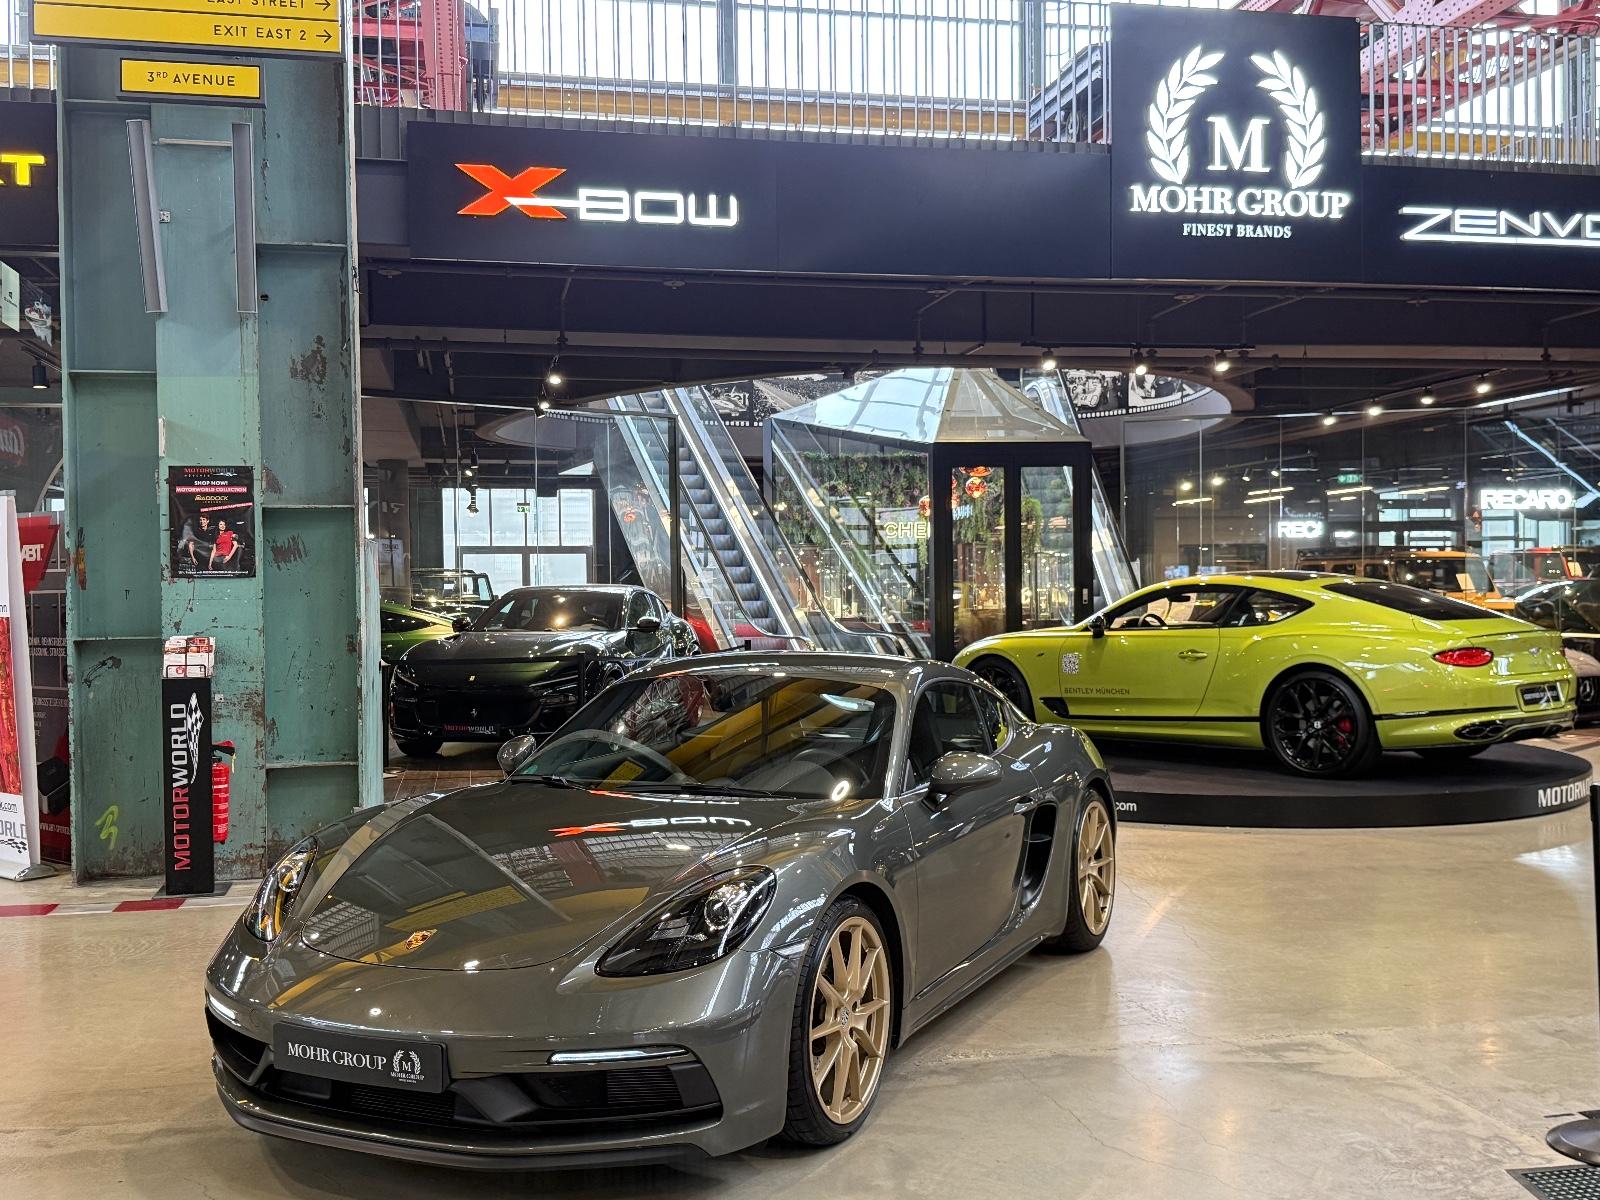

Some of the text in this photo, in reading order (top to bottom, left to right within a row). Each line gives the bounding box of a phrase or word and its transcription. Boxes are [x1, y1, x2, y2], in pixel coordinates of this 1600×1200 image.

[213, 25, 307, 41] EXIT EAST 2
[172, 73, 236, 87] AVENUE
[1206, 116, 1271, 173] M
[1130, 185, 1351, 219] MOHR GROUP
[1182, 223, 1292, 239] FINEST BRANDS
[1480, 488, 1573, 510] RECARO
[21, 544, 45, 562] ABT
[1064, 686, 1130, 695] BENTLEY MÜNCHEN
[170, 703, 191, 871] MOTORWORLD
[1537, 778, 1593, 808] MOTORW
[287, 1041, 387, 1070] MOHR GROUP
[402, 1061, 412, 1072] M
